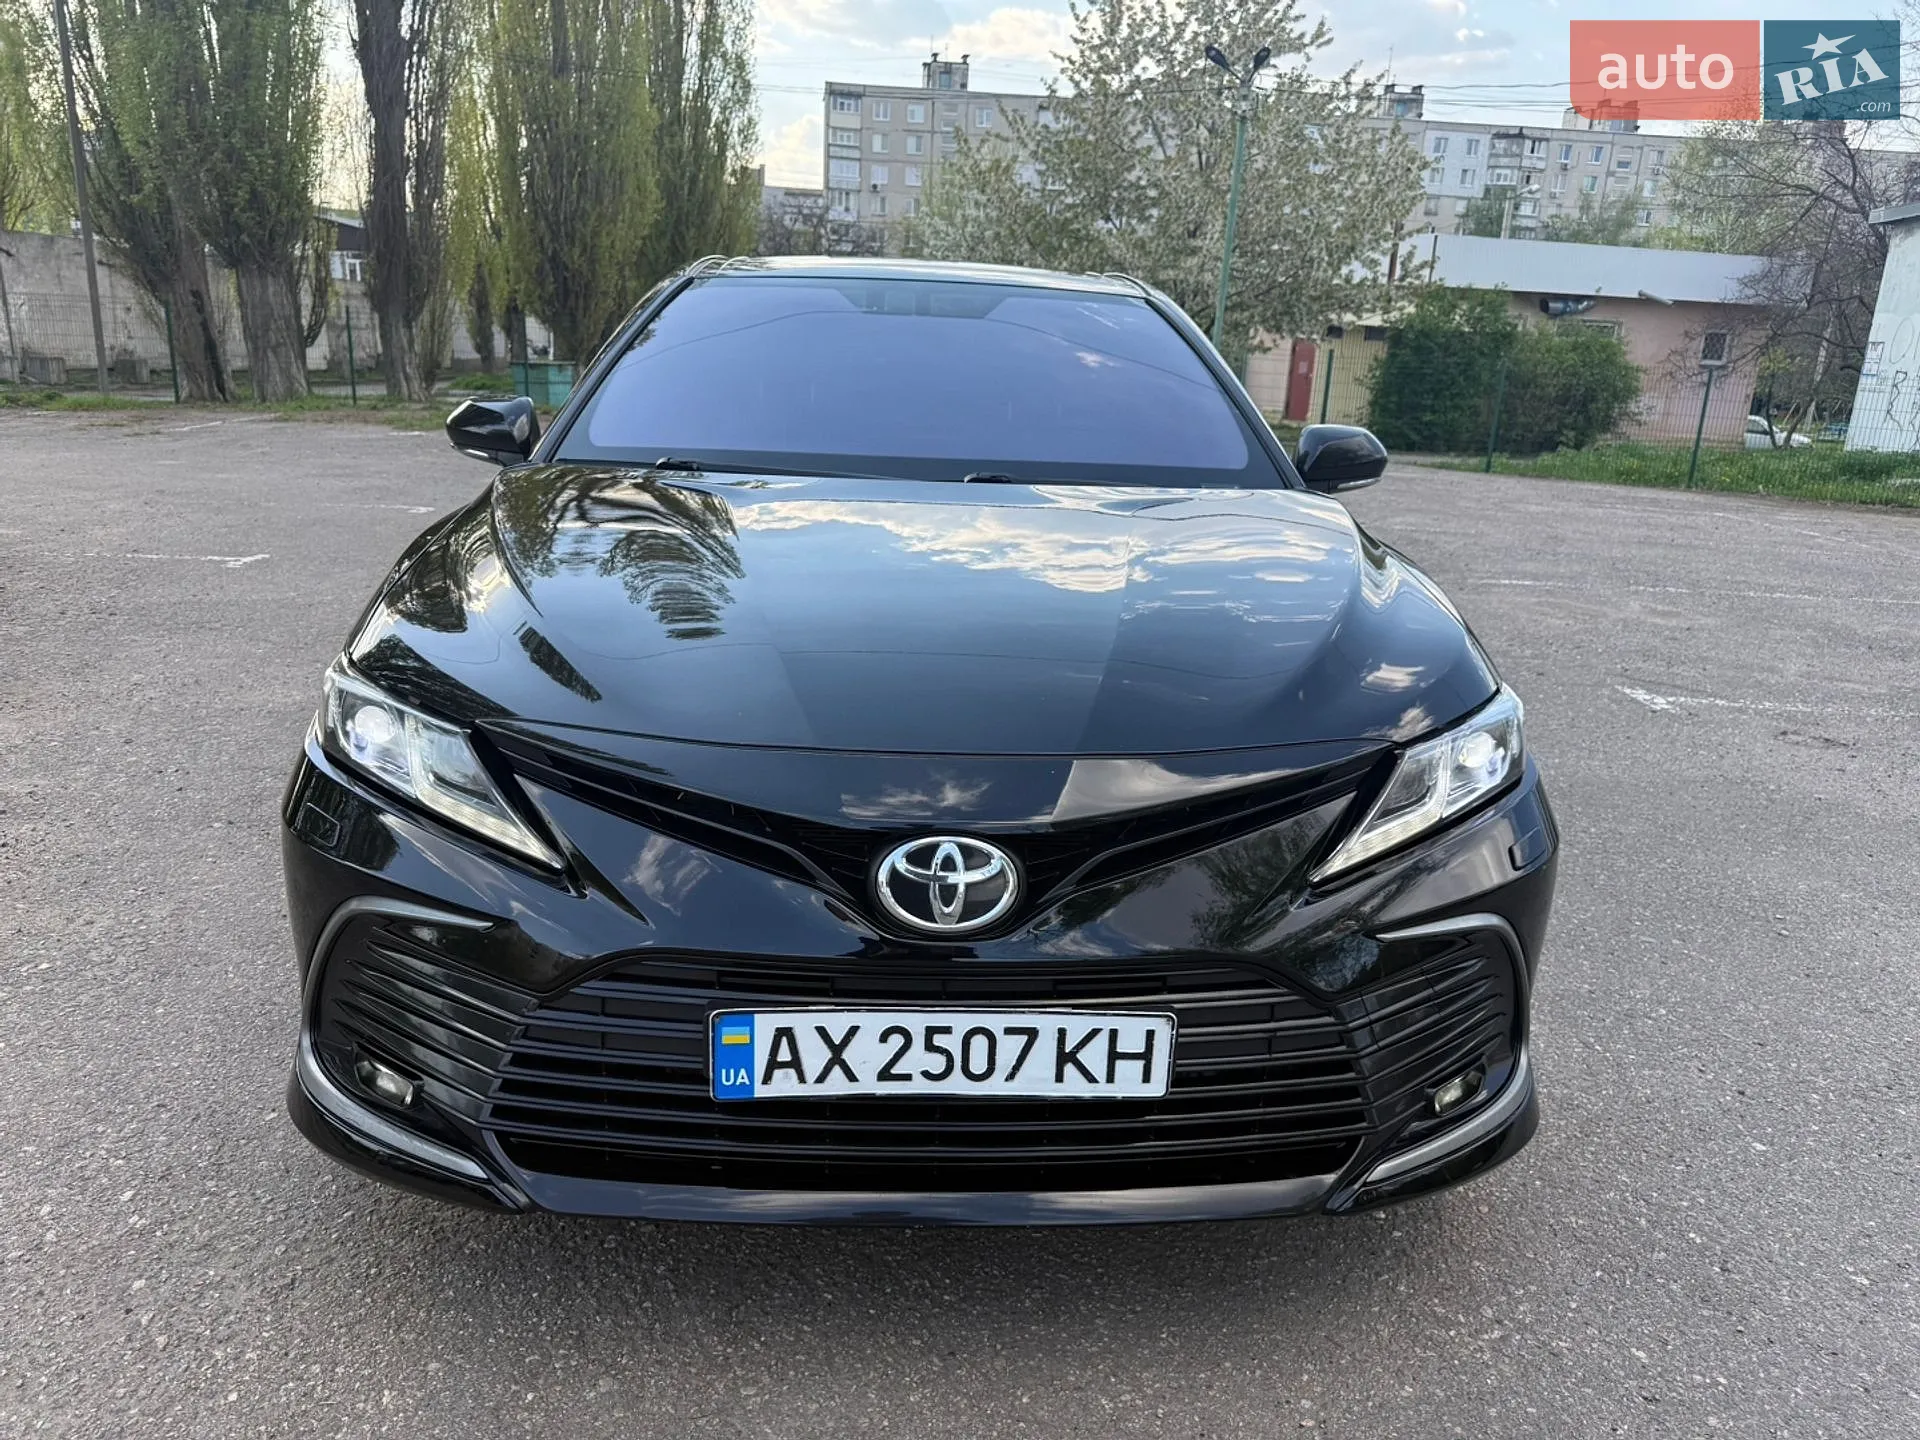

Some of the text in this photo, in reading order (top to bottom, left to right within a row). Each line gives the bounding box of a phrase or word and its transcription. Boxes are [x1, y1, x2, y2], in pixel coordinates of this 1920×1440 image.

[761, 1025, 1156, 1085] AX 2507 KH
[721, 1068, 751, 1086] UA
